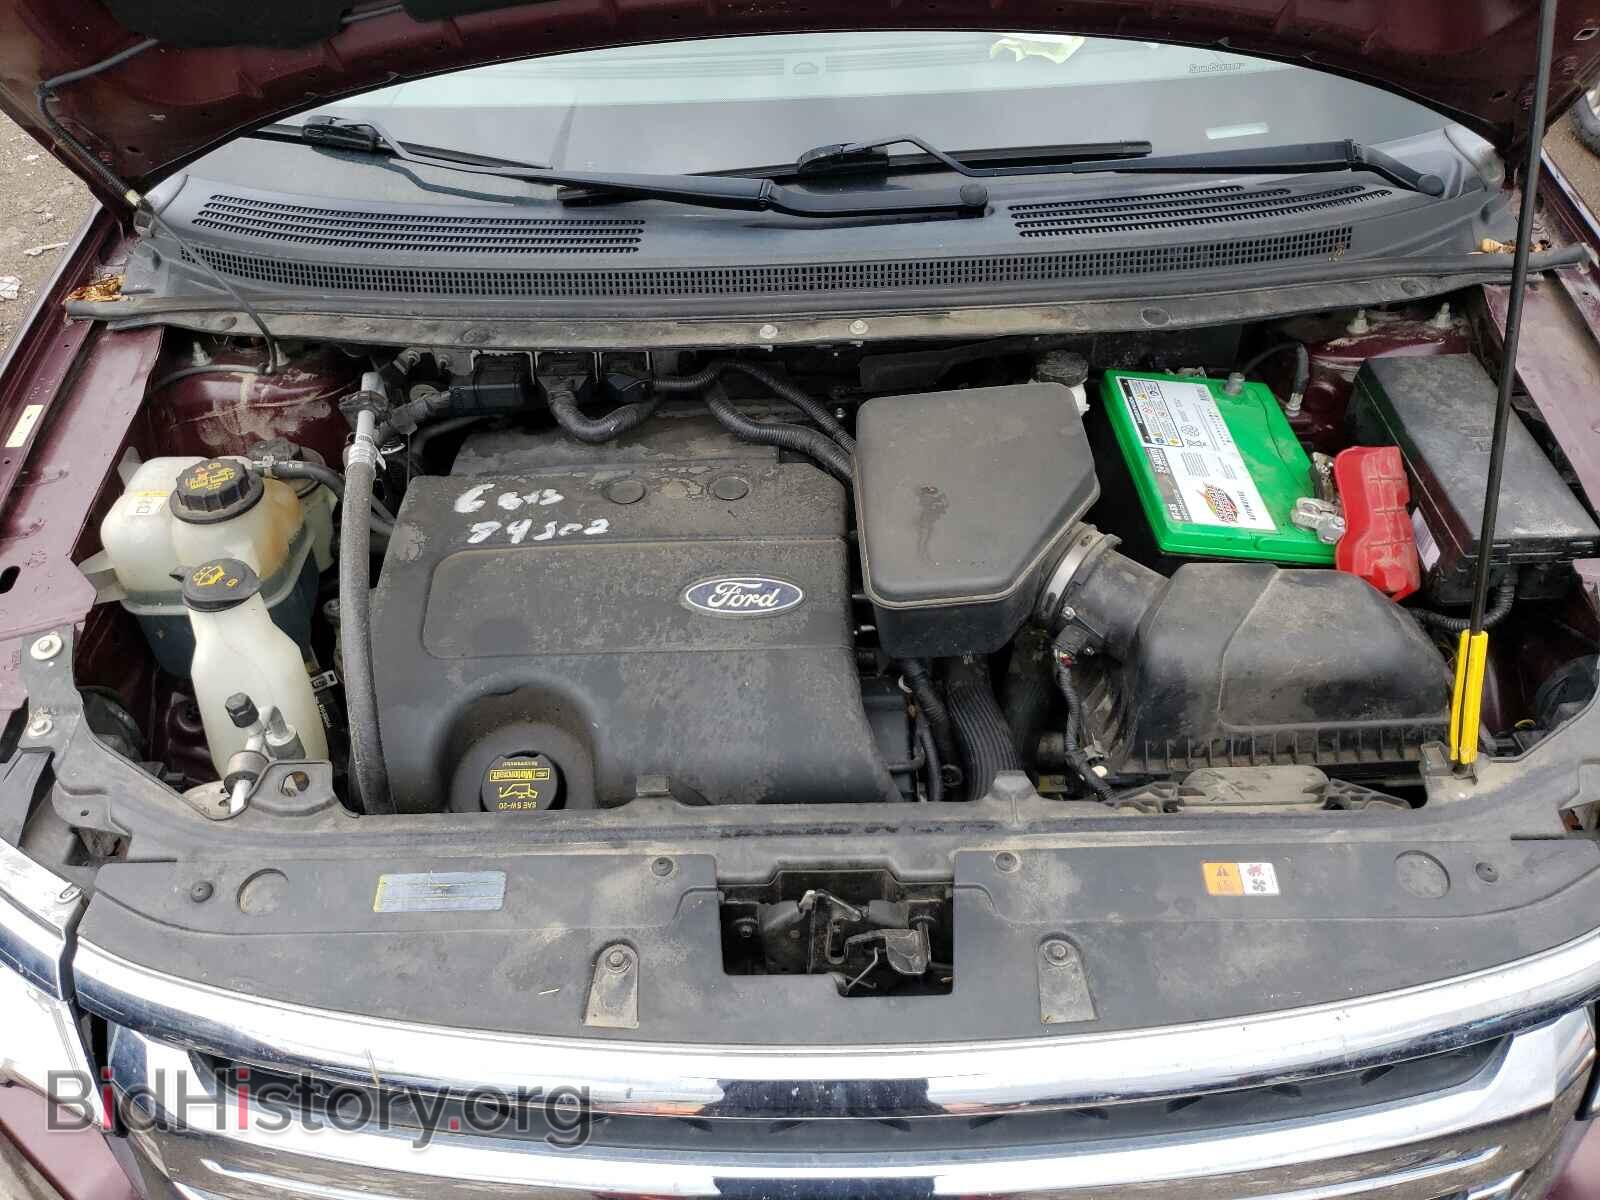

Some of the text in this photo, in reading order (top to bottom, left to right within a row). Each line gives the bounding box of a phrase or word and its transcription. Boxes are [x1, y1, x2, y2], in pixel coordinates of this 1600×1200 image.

[708, 582, 781, 607] Ford
[492, 769, 534, 780] Motorcraft
[523, 801, 537, 809] SAE
